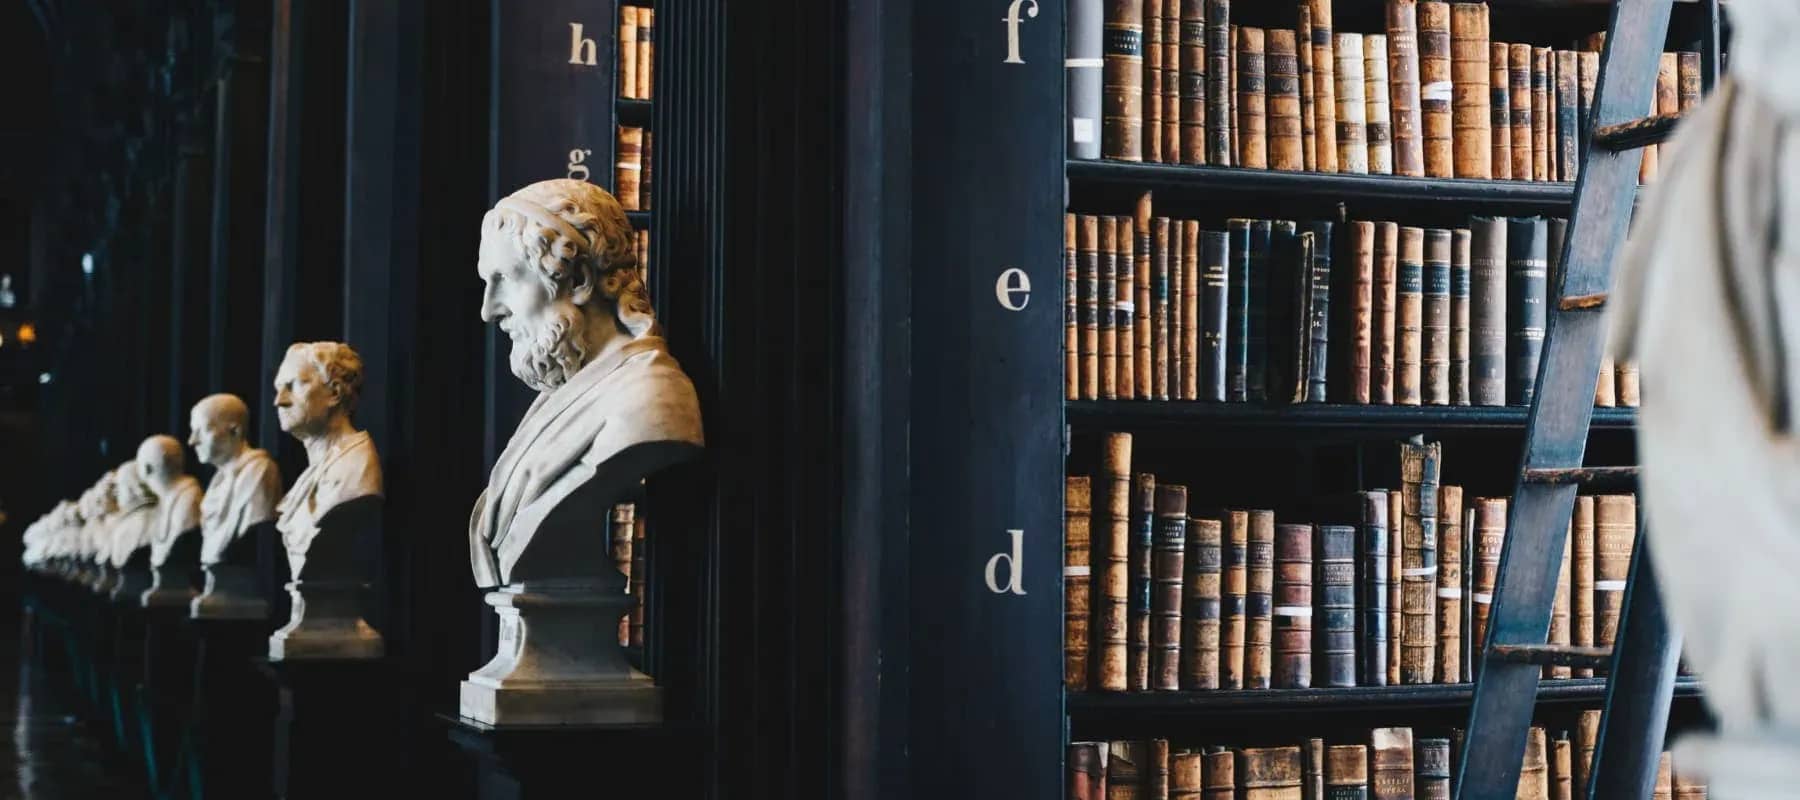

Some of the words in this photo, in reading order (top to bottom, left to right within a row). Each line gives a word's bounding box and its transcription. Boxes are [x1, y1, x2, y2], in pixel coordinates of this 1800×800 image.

[568, 23, 598, 66] h
[1001, 0, 1039, 64] f
[567, 149, 591, 182] g
[996, 267, 1031, 311] e
[984, 529, 1028, 595] d
